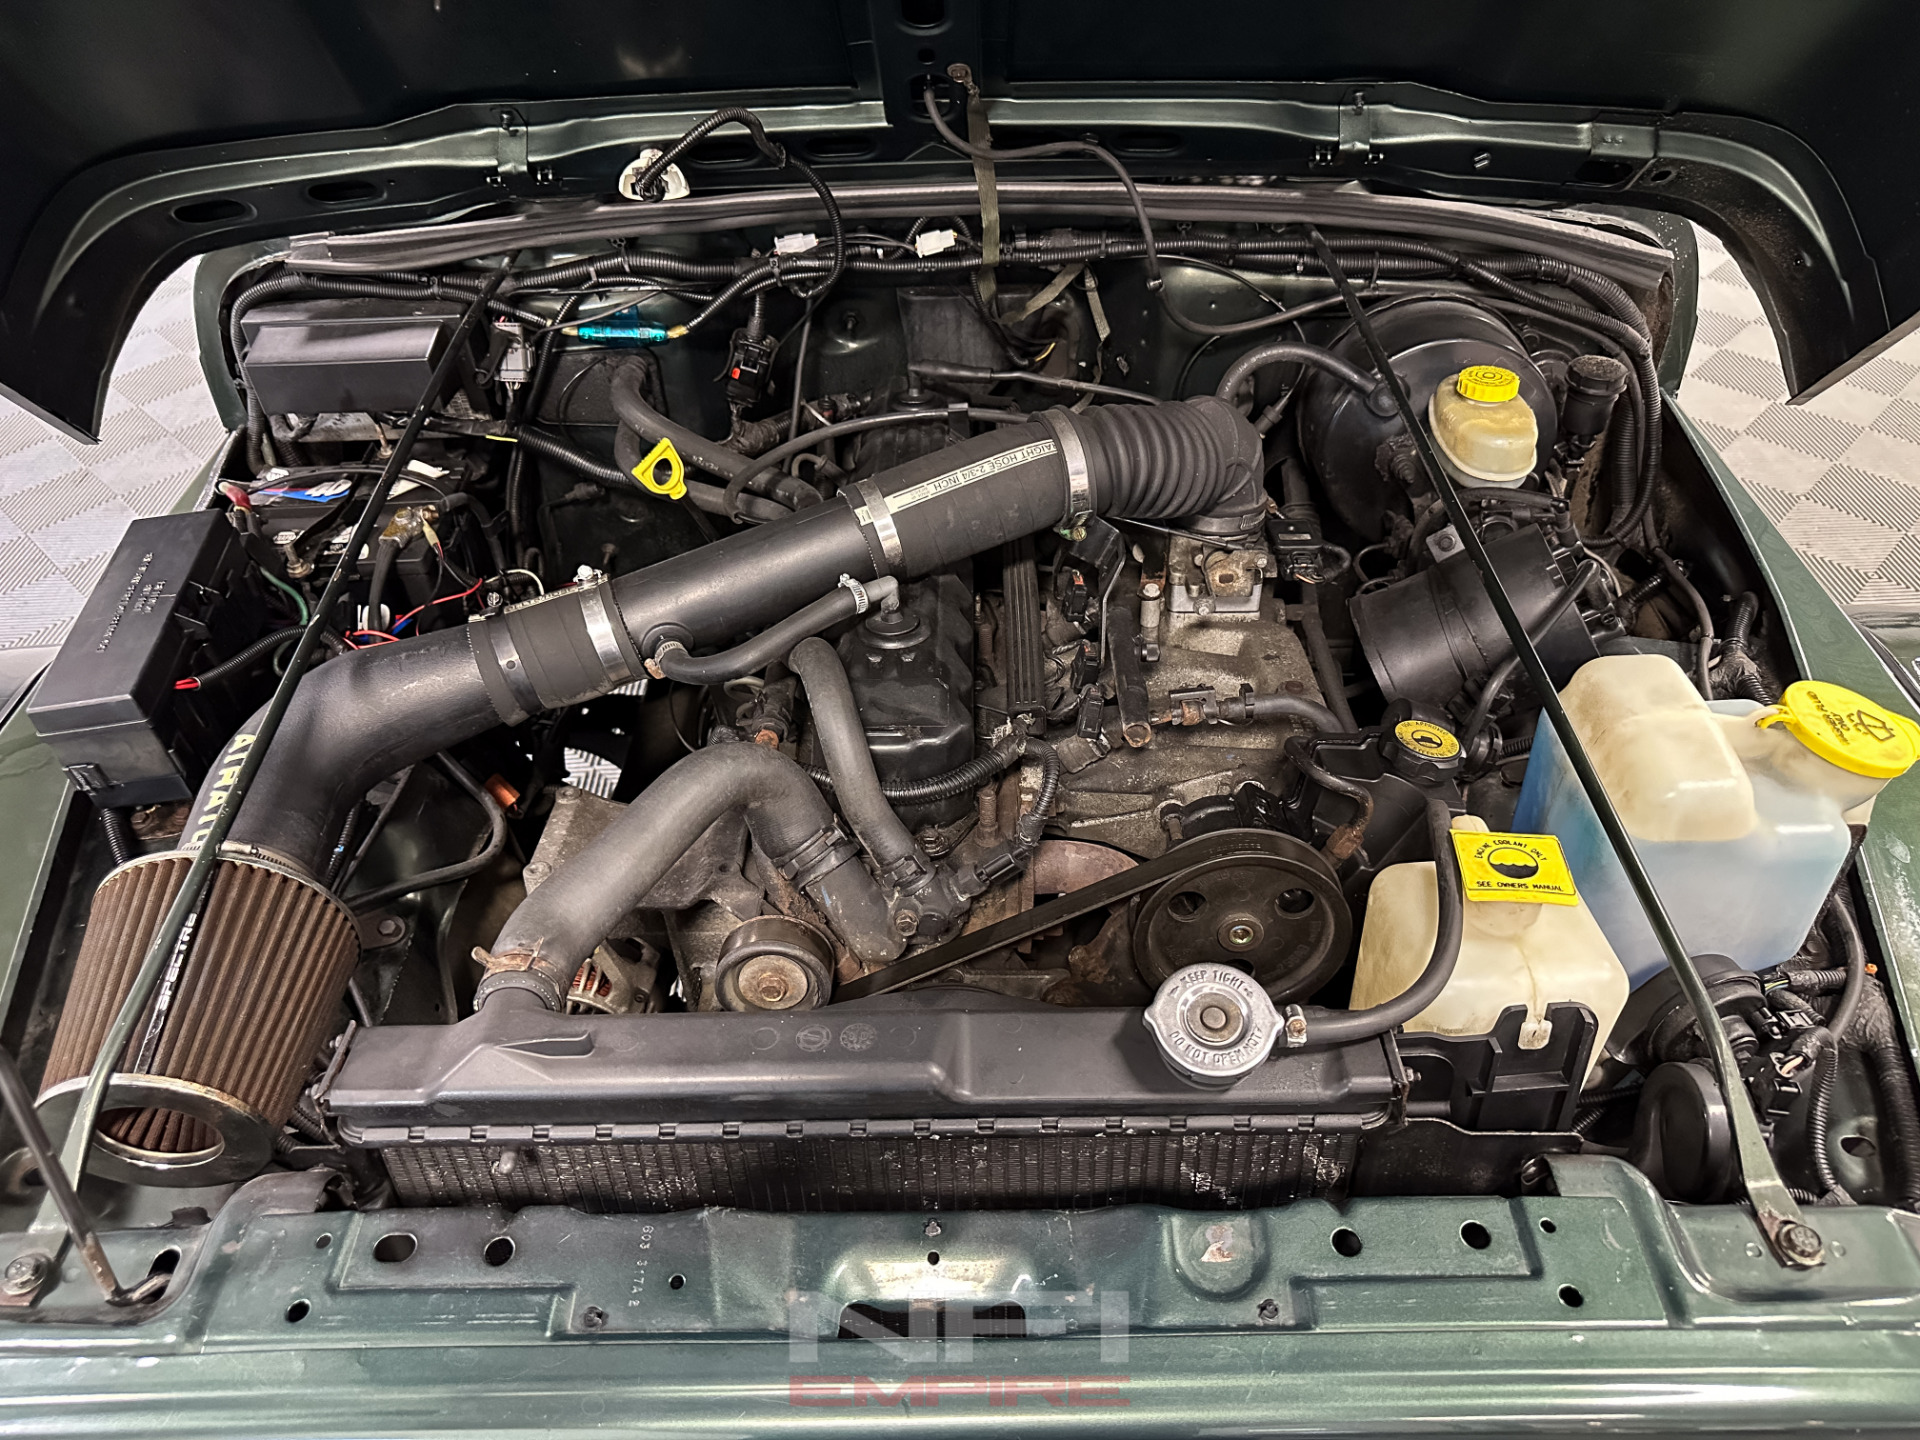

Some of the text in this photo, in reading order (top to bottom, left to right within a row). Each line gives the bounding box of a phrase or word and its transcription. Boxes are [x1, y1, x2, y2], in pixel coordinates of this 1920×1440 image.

[989, 453, 1018, 470] HOSE
[961, 464, 986, 480] 2-3/4
[933, 476, 960, 492] INCH
[1474, 839, 1548, 861] ENGINE COOLANT ONLY
[1532, 884, 1564, 892] MANUAL
[1180, 970, 1246, 990] KEEP TIGHT
[1169, 1030, 1185, 1047] DO
[1186, 1045, 1208, 1063] NOT
[1213, 1050, 1247, 1064] OPEN
[639, 1225, 655, 1249] 603
